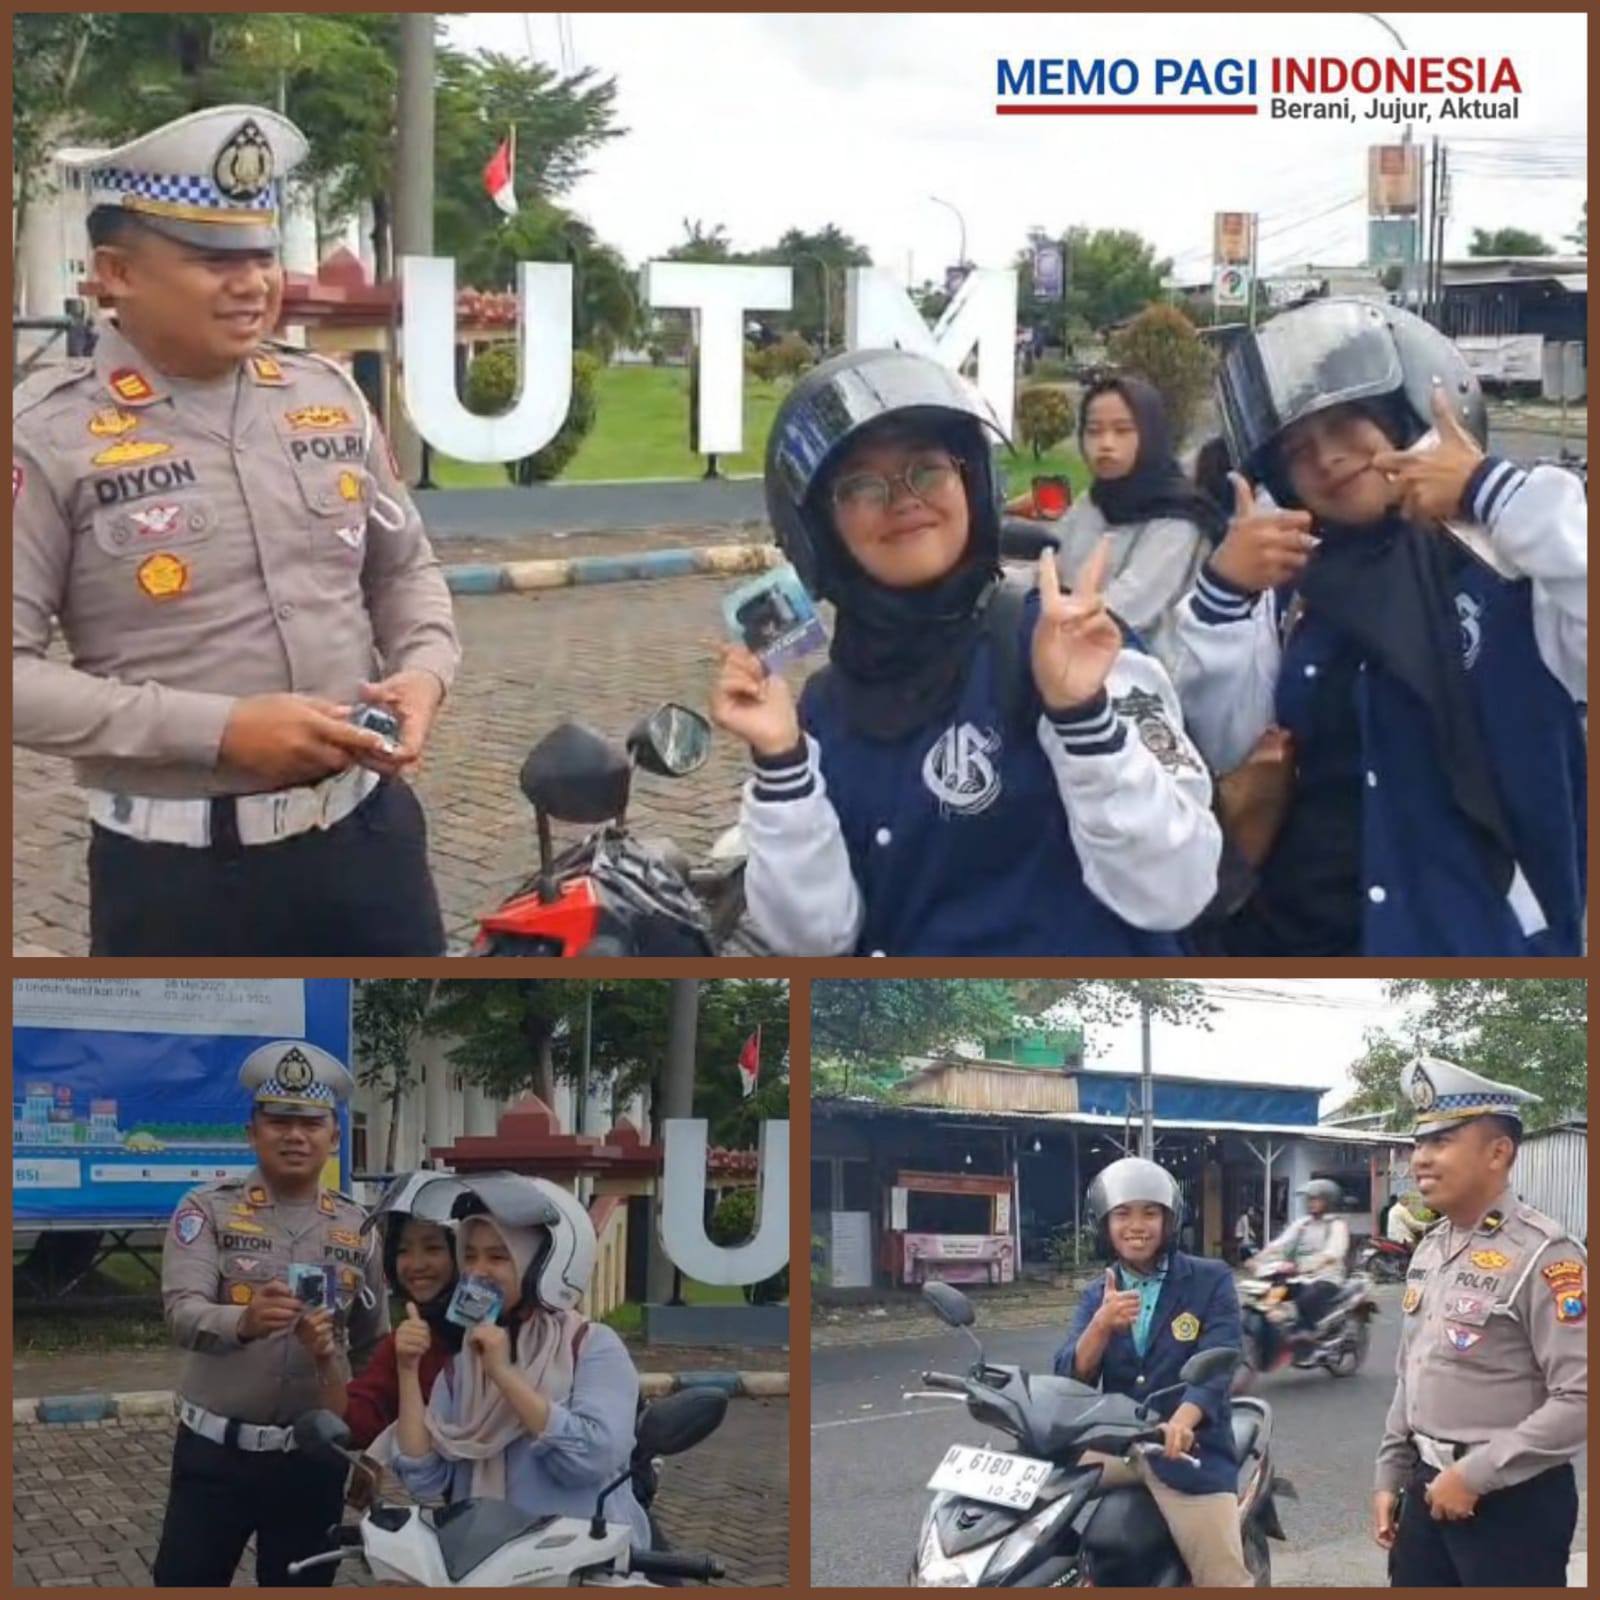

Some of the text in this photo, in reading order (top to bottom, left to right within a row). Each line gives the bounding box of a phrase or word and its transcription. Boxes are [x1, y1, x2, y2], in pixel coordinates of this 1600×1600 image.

[291, 436, 364, 463] POLRI
[94, 460, 195, 505] DIYON
[659, 1118, 790, 1286] U
[223, 1234, 273, 1250] DIYON
[1456, 1272, 1500, 1293] POLRI
[969, 1453, 1014, 1477] 6180
[1022, 1465, 1047, 1485] GJ
